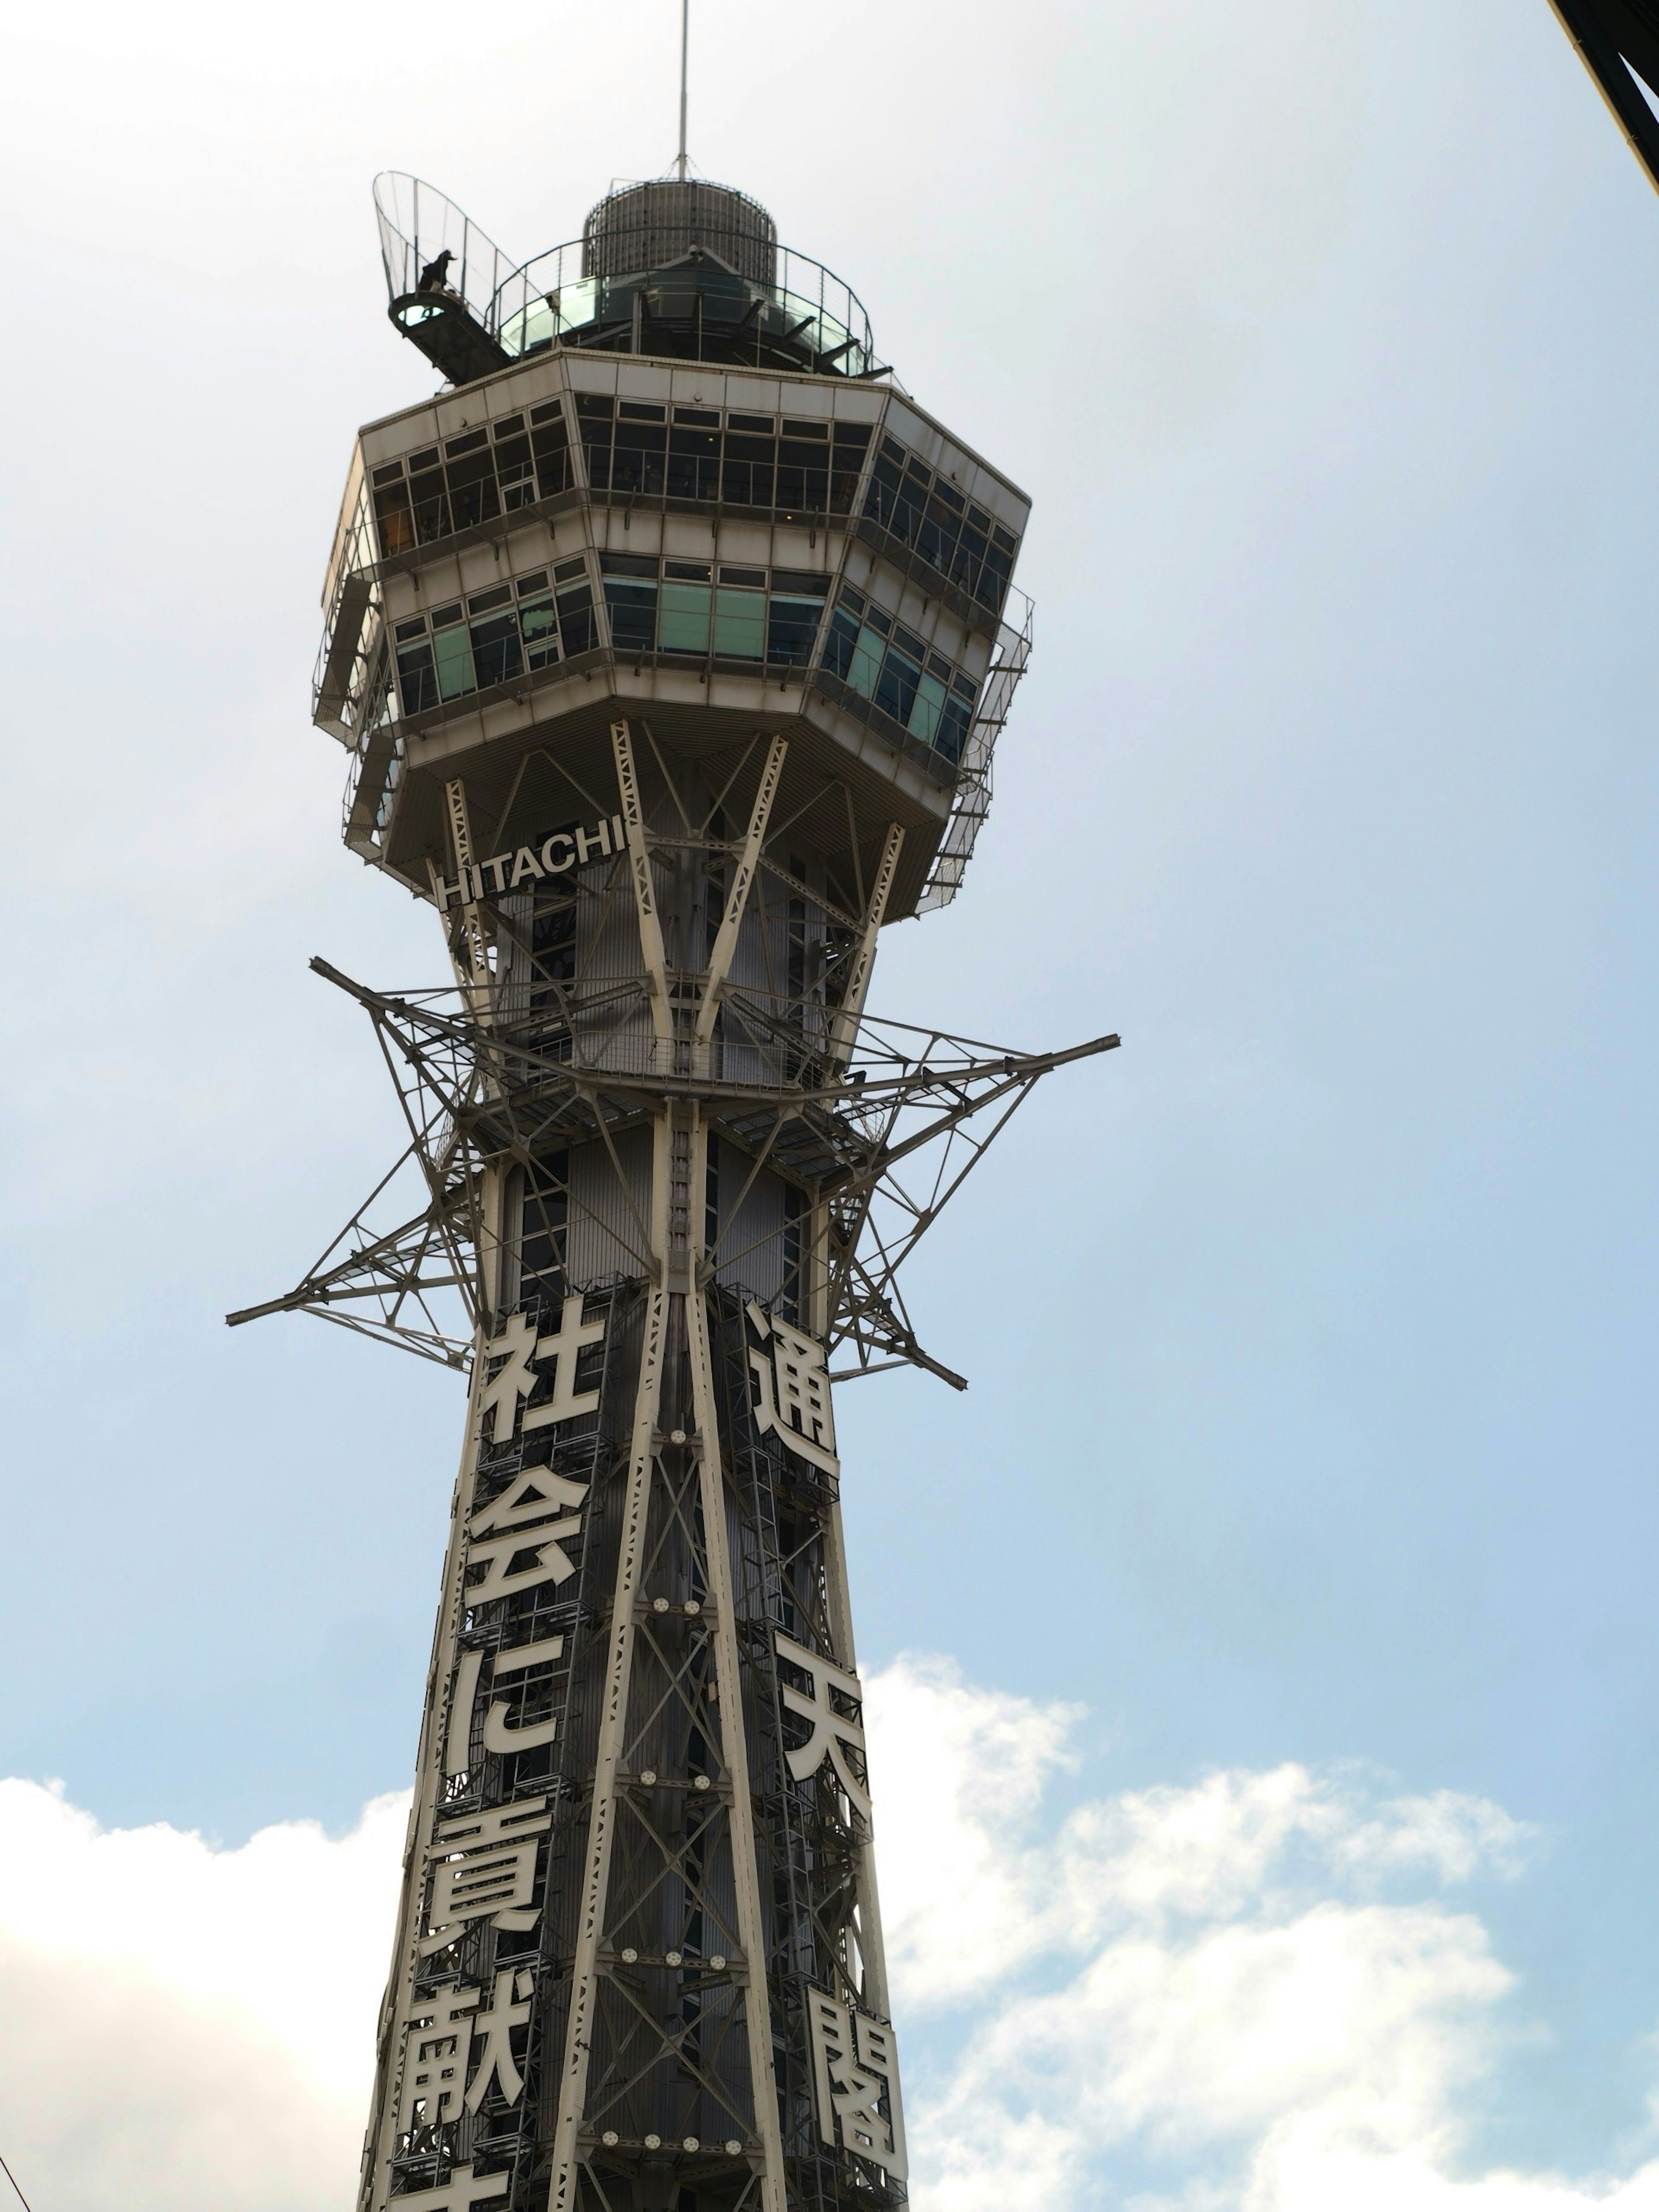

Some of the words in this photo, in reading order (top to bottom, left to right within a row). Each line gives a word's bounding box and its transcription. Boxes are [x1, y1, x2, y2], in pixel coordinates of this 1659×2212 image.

[435, 814, 625, 912] HITACHI
[745, 1298, 908, 2183] 通天閣
